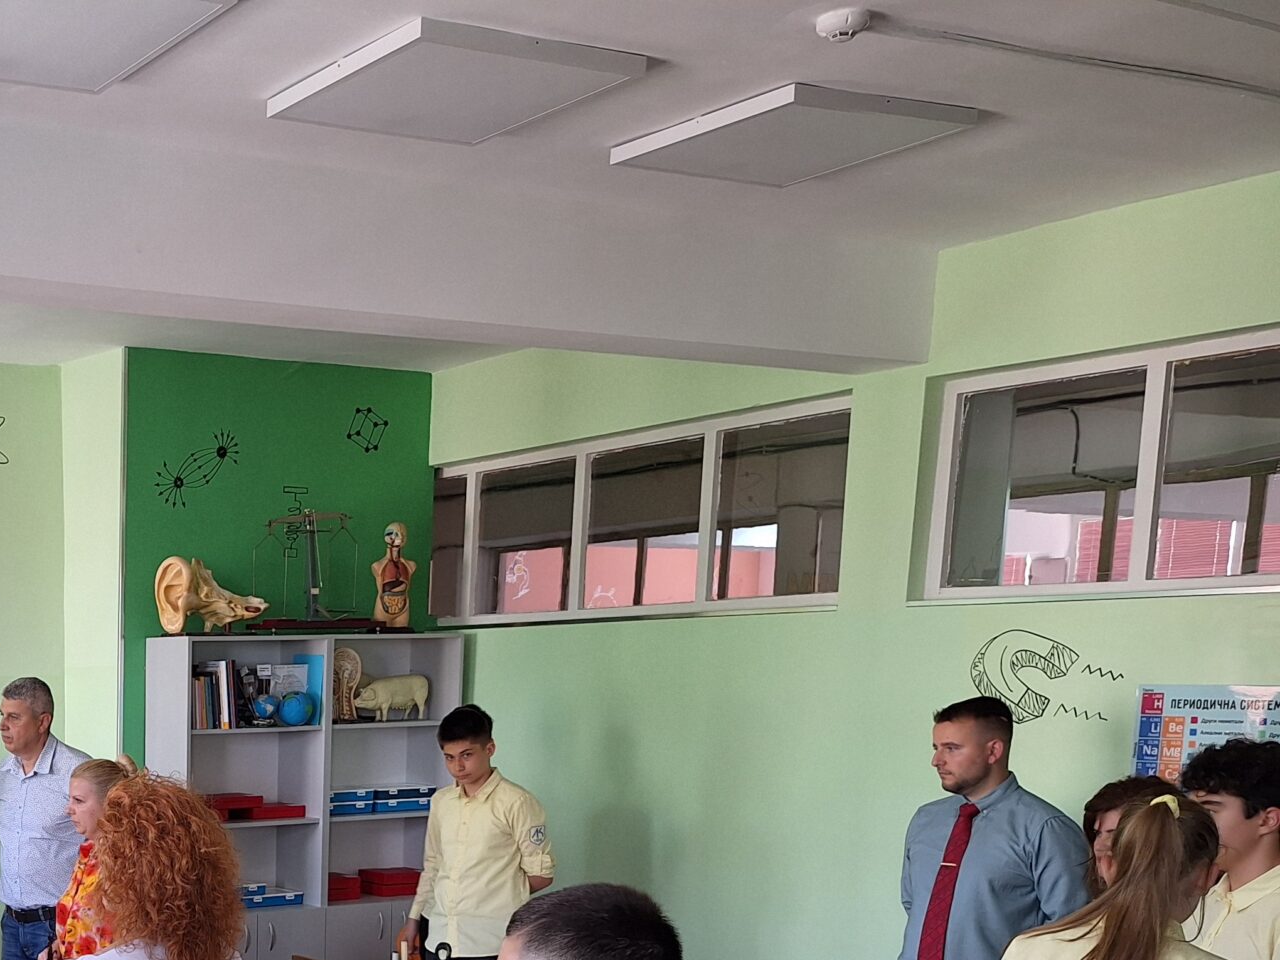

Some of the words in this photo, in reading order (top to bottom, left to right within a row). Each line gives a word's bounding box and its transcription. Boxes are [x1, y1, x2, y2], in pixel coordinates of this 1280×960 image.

[1153, 698, 1163, 709] H
[1170, 698, 1236, 710] ПЕРИОДИЧНА
[1151, 722, 1160, 733] Li
[1168, 722, 1183, 733] Be
[1143, 744, 1158, 755] Na
[1163, 747, 1180, 757] Mg
